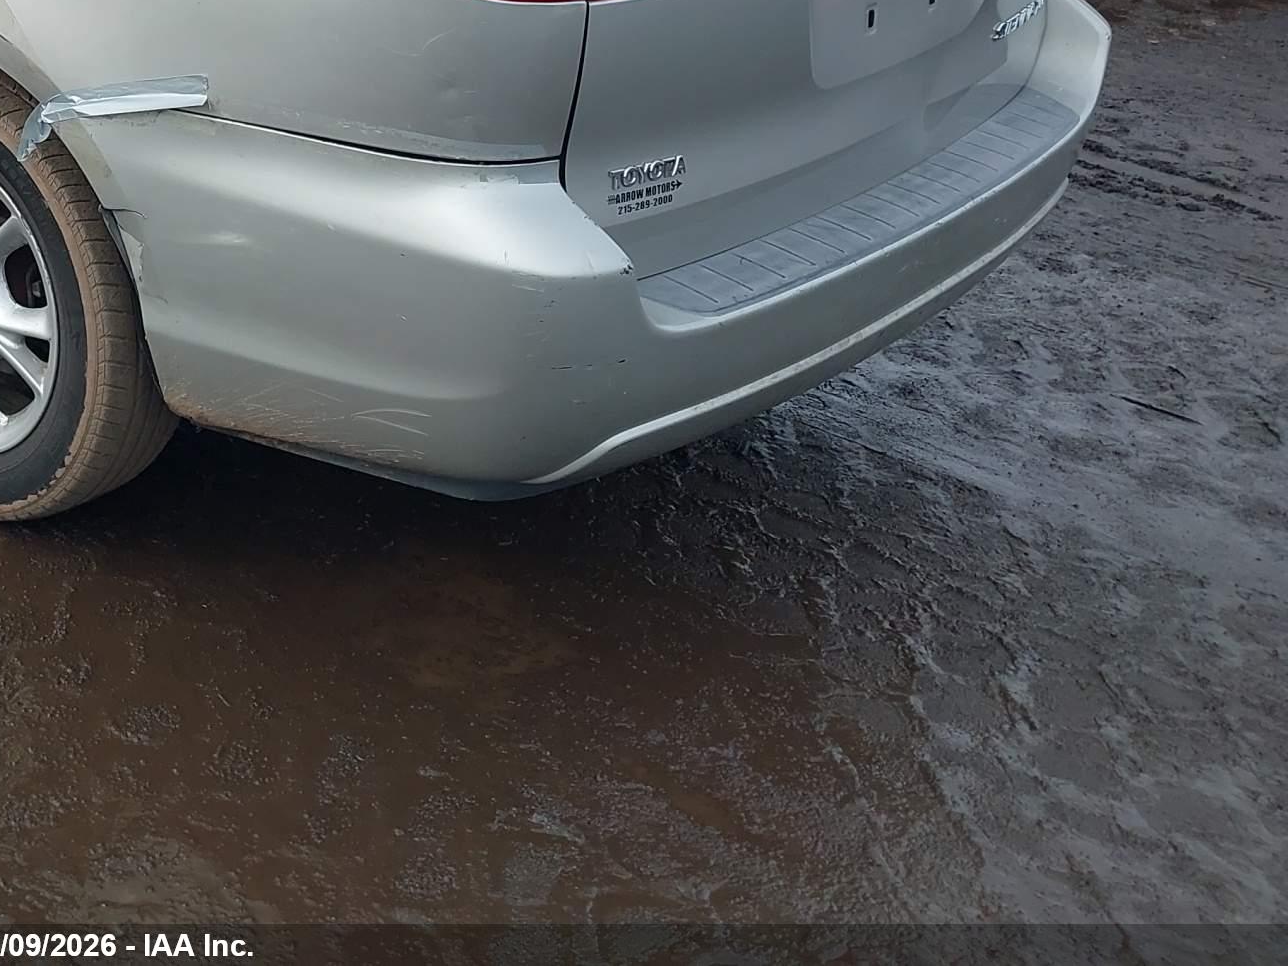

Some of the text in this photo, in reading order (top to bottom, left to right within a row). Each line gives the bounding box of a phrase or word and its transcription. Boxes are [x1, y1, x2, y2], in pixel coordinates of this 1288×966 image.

[608, 155, 687, 190] TOYOTA
[615, 181, 675, 204] ARROW MOTORS
[618, 194, 673, 215] 215-289-2000
